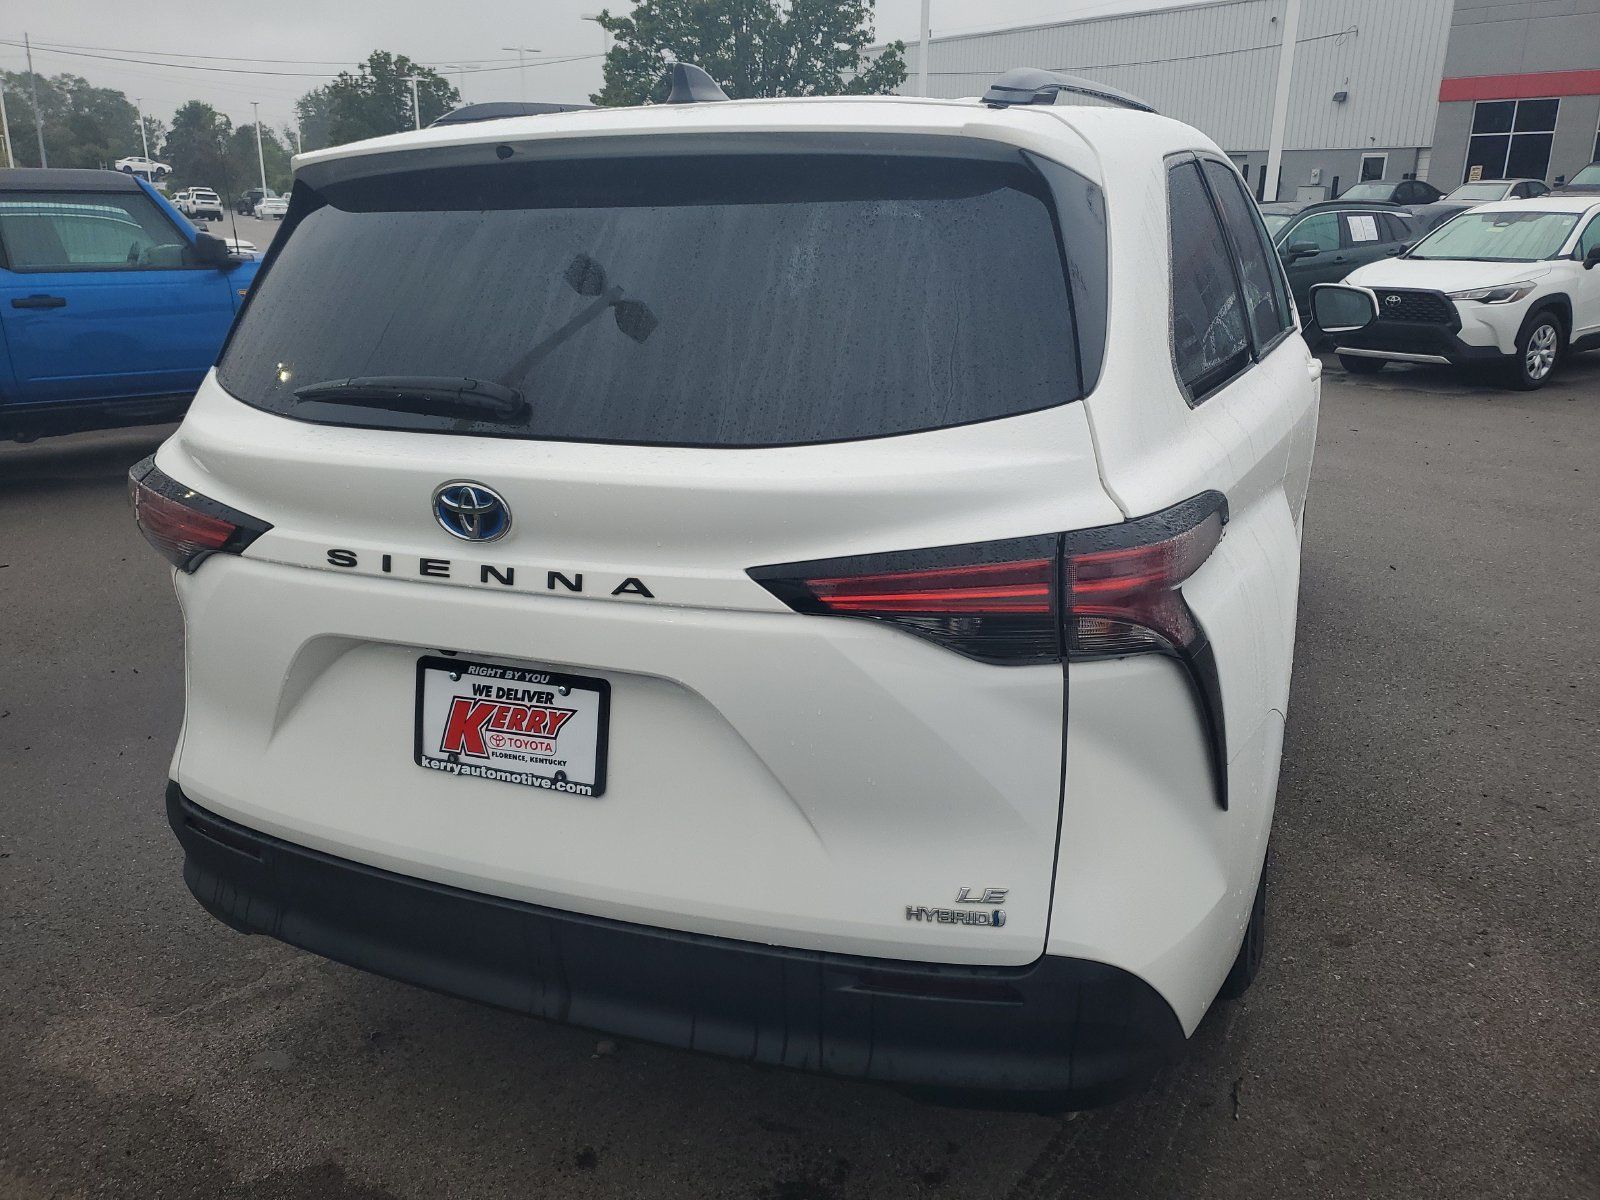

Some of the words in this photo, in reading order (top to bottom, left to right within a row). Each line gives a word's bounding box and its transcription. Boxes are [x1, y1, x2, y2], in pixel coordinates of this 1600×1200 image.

[327, 549, 655, 598] SIENNA
[468, 665, 503, 678] RIGHT
[505, 671, 520, 680] BY
[524, 673, 550, 684] YOU
[472, 683, 493, 698] WE
[496, 686, 555, 705] DELIVER
[442, 698, 572, 757] KERRY
[508, 738, 553, 752] TOYOTA
[491, 751, 528, 763] FLORENCE,
[529, 756, 568, 767] KENTUCKY
[421, 755, 592, 796] kerryautomotive.com
[955, 887, 1009, 904] LE
[906, 905, 991, 926] HYBRID
